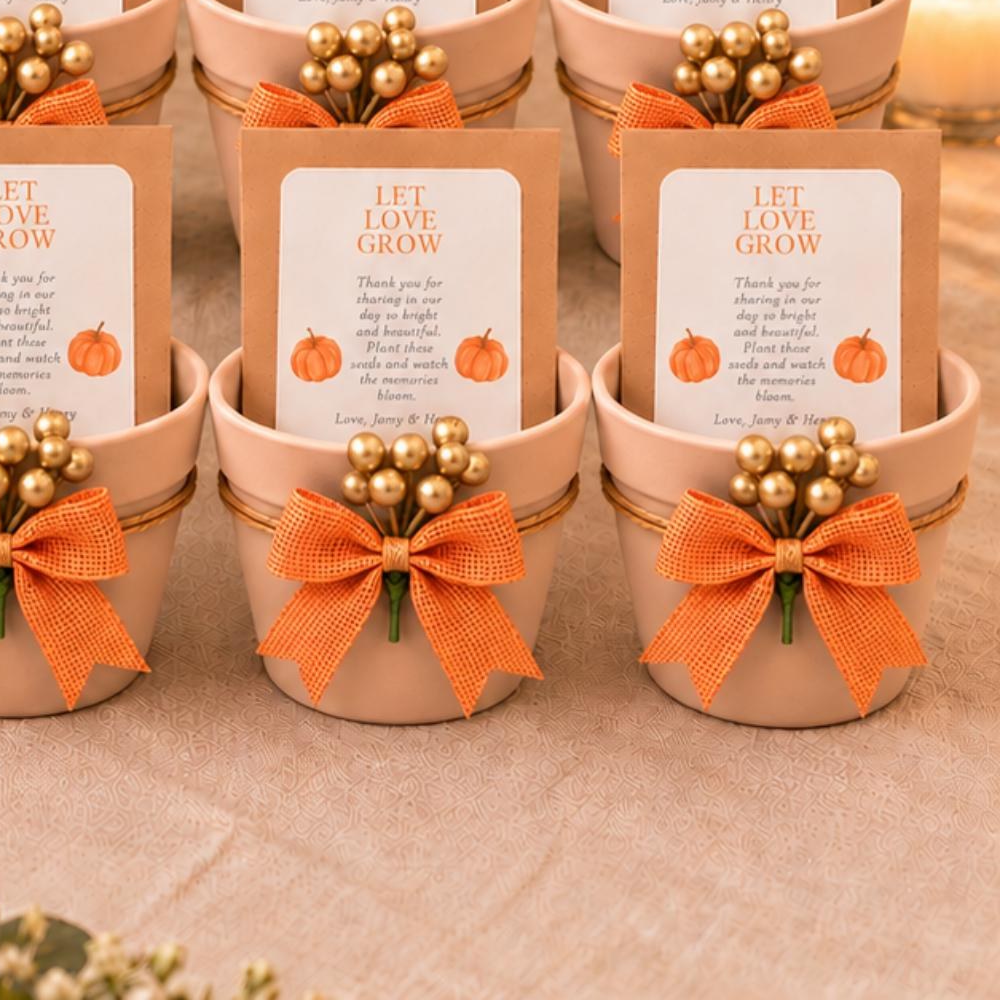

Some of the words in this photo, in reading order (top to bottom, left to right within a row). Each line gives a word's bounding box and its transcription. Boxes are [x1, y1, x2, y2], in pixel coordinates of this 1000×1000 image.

[375, 184, 425, 207] LET
[754, 185, 805, 207] LET
[365, 209, 437, 230] LOVE
[743, 209, 816, 231] LOVE
[356, 232, 443, 254] GROW
[734, 233, 822, 254] GROW
[12, 274, 34, 286] you
[36, 271, 55, 286] for
[358, 276, 395, 288] Thank
[399, 279, 421, 291] you
[424, 276, 443, 291] for
[735, 276, 774, 289] Thank
[778, 280, 800, 292] you
[802, 276, 821, 292] for
[19, 288, 31, 300] in
[34, 290, 55, 300] our
[356, 292, 402, 307] sharing
[406, 293, 417, 305] in
[422, 296, 442, 305] our
[734, 293, 780, 308] sharing
[784, 294, 796, 306] in
[800, 296, 821, 306] our
[17, 335, 47, 347] these
[366, 340, 400, 353] Plant
[404, 340, 433, 353] these
[738, 373, 756, 385] the
[760, 374, 816, 385] memories
[22, 407, 35, 419] &
[408, 412, 420, 424] &
[786, 413, 799, 425] &
